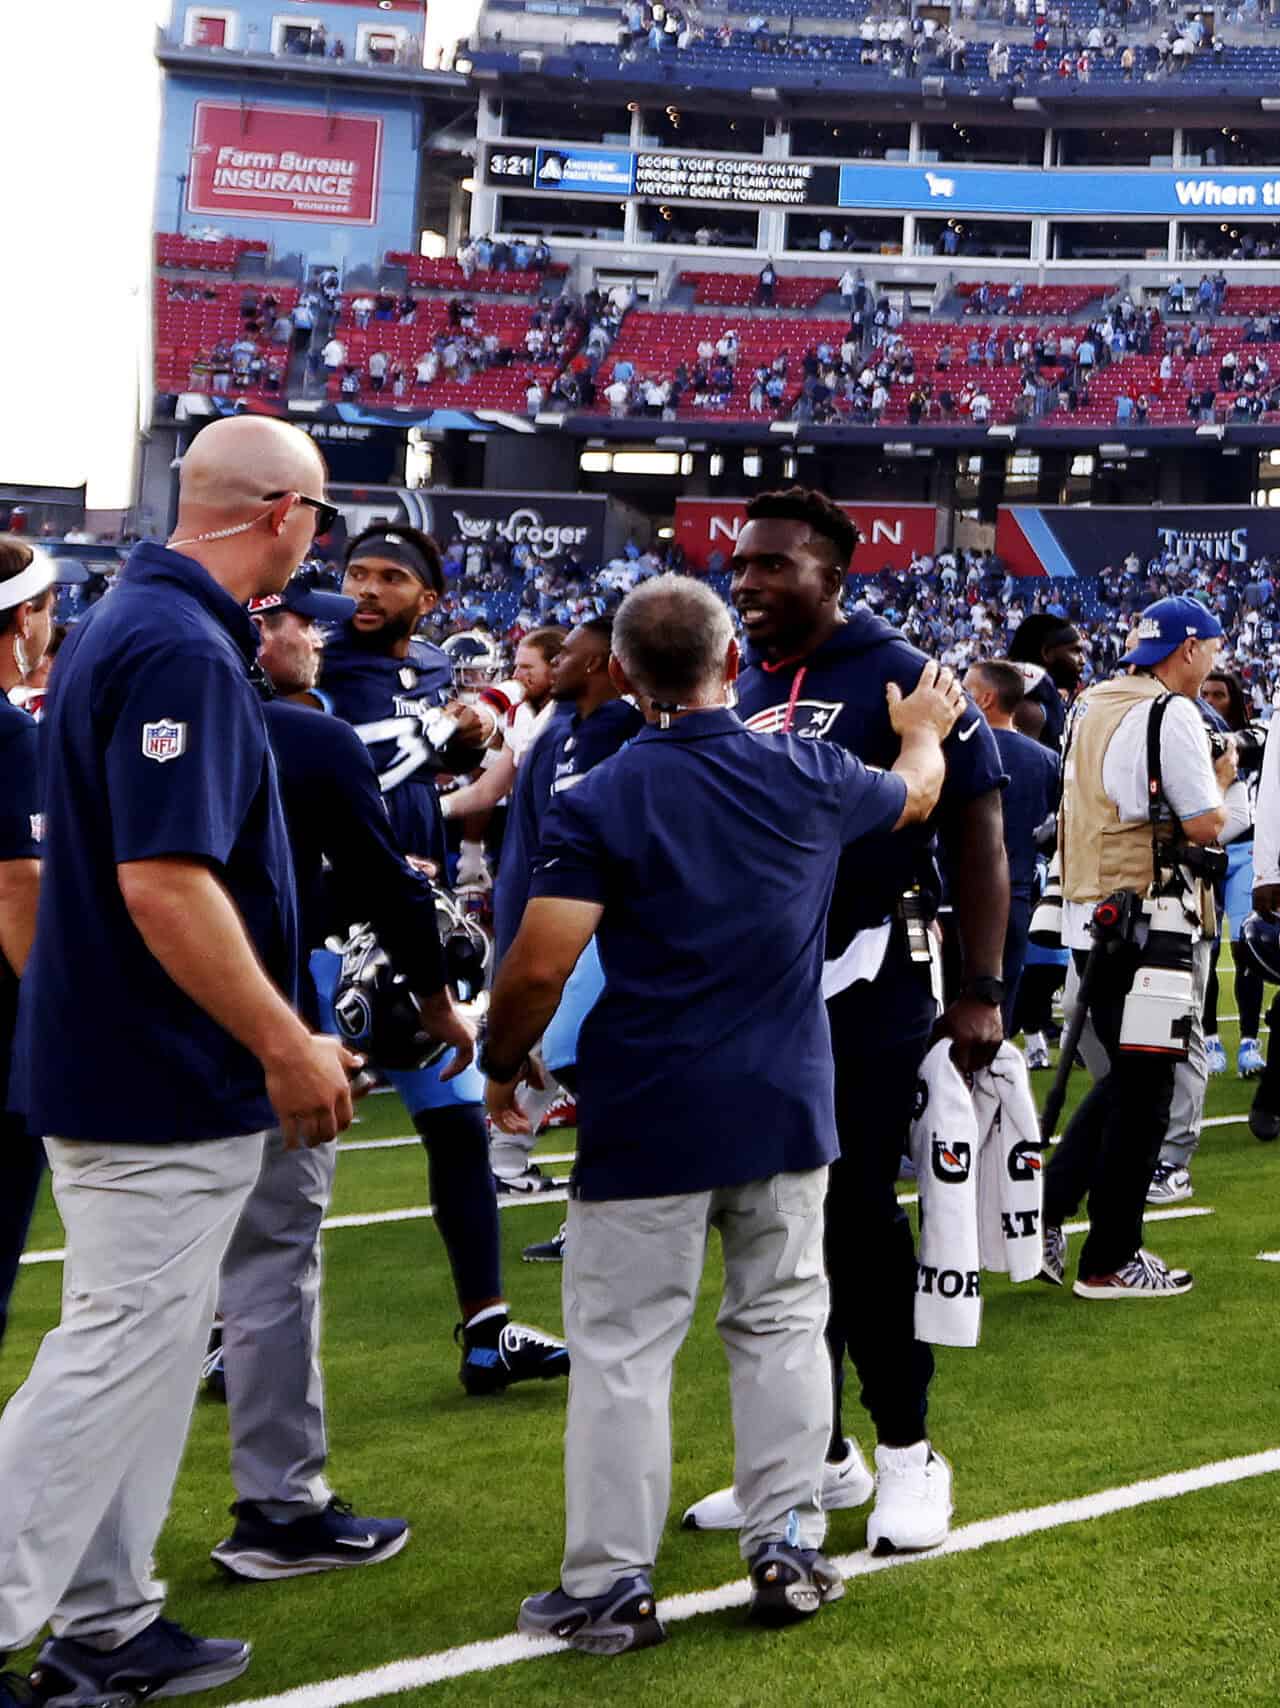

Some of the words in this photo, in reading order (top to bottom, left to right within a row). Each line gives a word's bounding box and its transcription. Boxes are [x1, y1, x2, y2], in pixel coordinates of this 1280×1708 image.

[217, 147, 273, 168] Farm
[279, 151, 353, 174] Bureau
[490, 155, 531, 176] 3:21
[680, 158, 714, 172] YOUR
[768, 164, 787, 177] ON
[787, 166, 811, 178] THE
[213, 168, 352, 196] INSURANCE
[635, 181, 688, 196] VICTORY
[687, 171, 714, 184] APP
[715, 173, 730, 186] TO
[733, 174, 769, 188] CLAIM
[770, 177, 803, 190] YOUR
[1175, 180, 1256, 206] When
[496, 509, 587, 558] Kroger
[1158, 528, 1248, 562] TITANS
[151, 739, 177, 753] NFL
